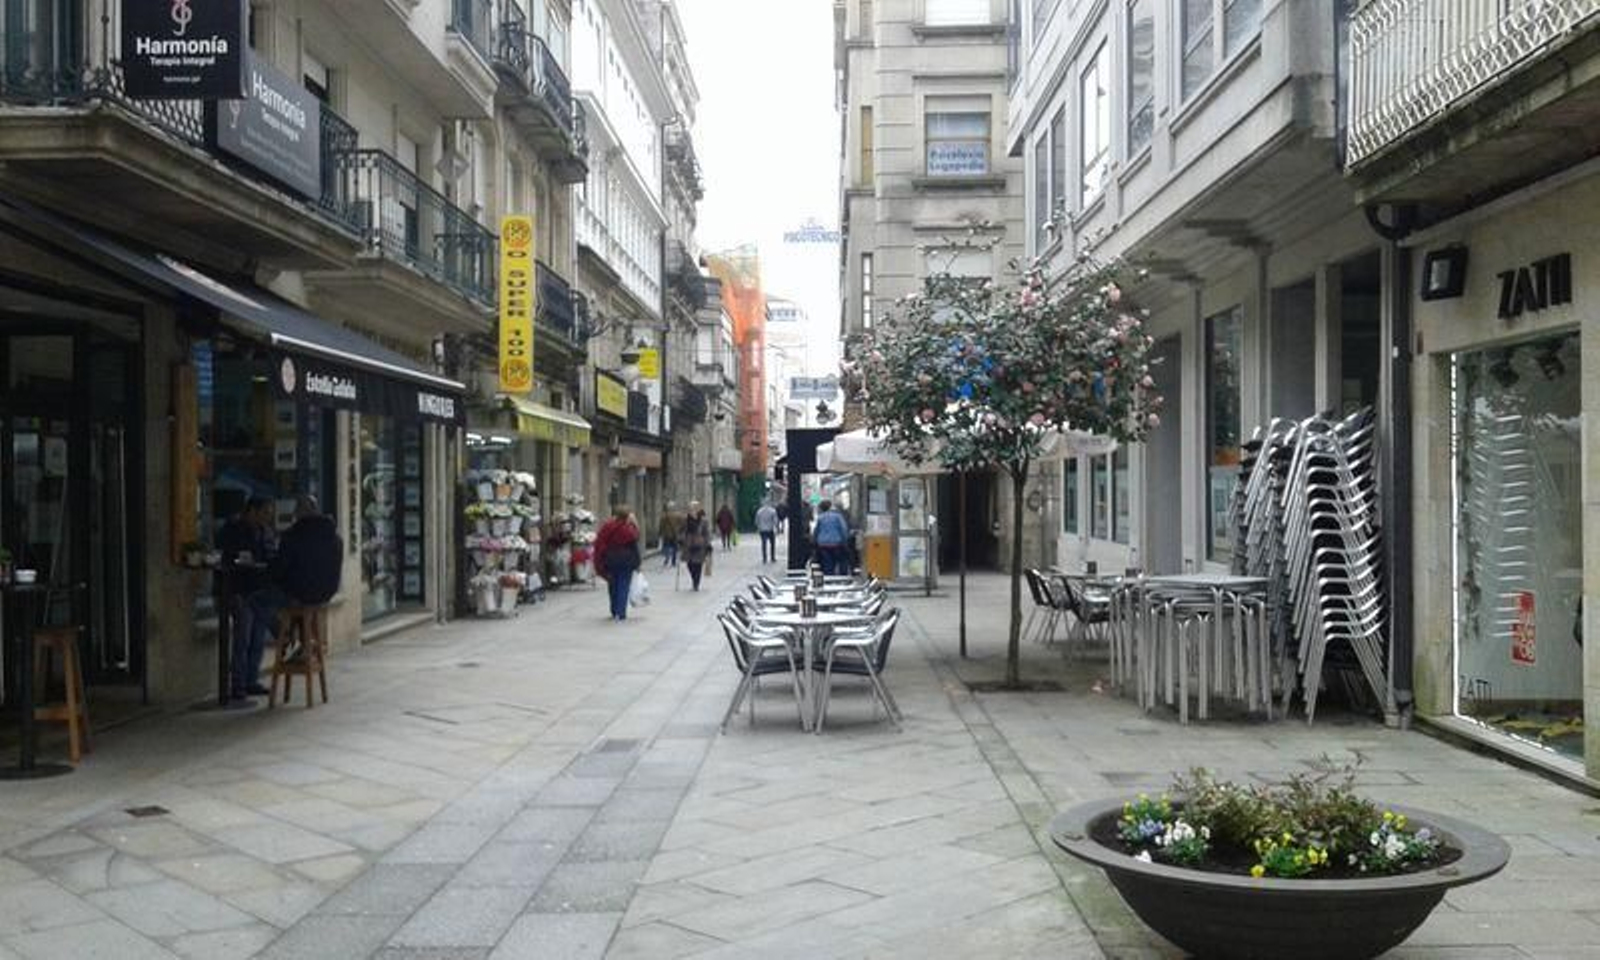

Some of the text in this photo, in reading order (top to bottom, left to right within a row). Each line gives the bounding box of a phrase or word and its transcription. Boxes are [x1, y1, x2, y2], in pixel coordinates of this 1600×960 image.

[136, 35, 229, 55] Harmonía
[150, 56, 215, 66] Terapia Integral
[252, 71, 307, 130] Harmonía
[507, 268, 526, 317] SUPER
[508, 329, 524, 356] 100
